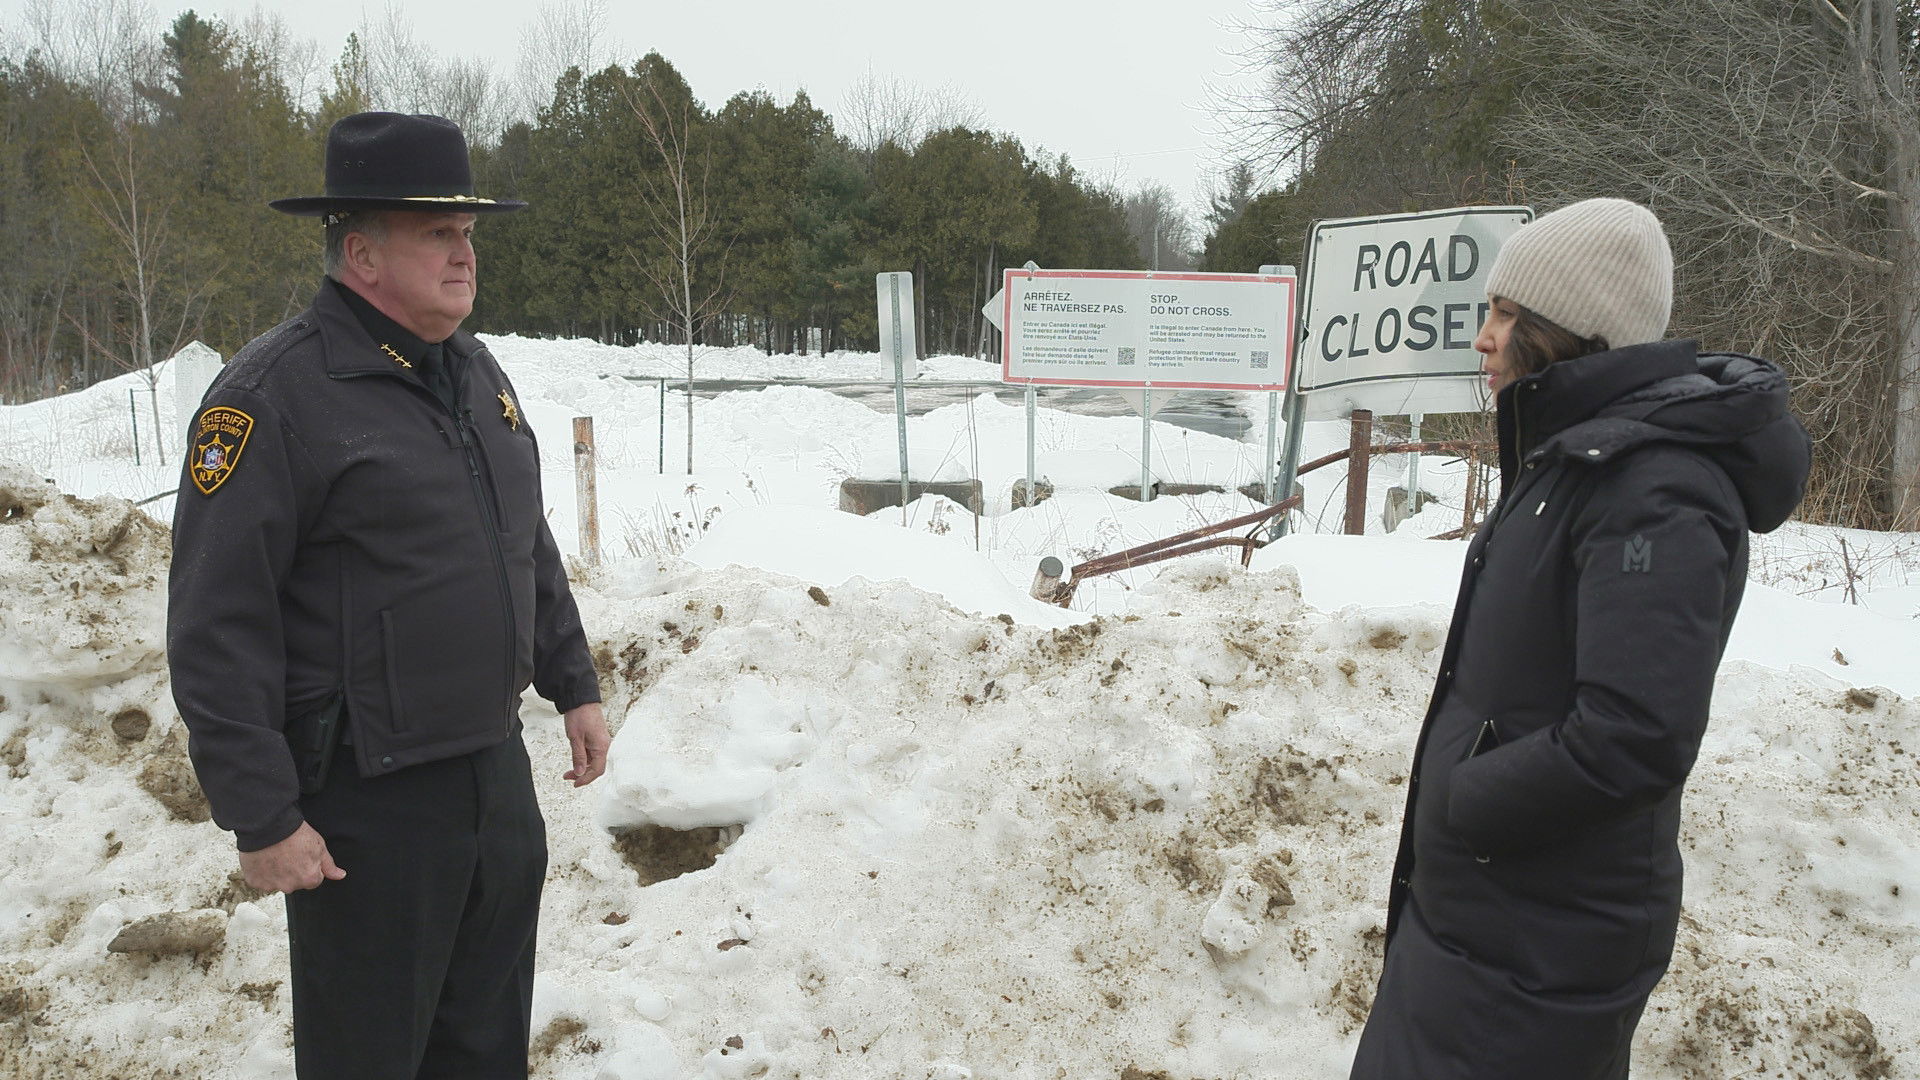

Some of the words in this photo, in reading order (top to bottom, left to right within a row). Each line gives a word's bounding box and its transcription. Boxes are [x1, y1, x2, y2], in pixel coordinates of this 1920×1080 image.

[1353, 234, 1480, 292] ROAD
[1023, 290, 1073, 302] ARRÊTEZ.
[1150, 294, 1181, 304] STOP.
[1023, 303, 1038, 312] NE
[1040, 303, 1101, 313] TRAVERSEZ
[1103, 304, 1127, 314] PAS.
[1150, 306, 1165, 315] DO
[1168, 306, 1190, 316] NOT
[1192, 306, 1233, 317] CROSS.
[201, 412, 247, 429] SHERIFF
[220, 423, 244, 438] COUNTY
